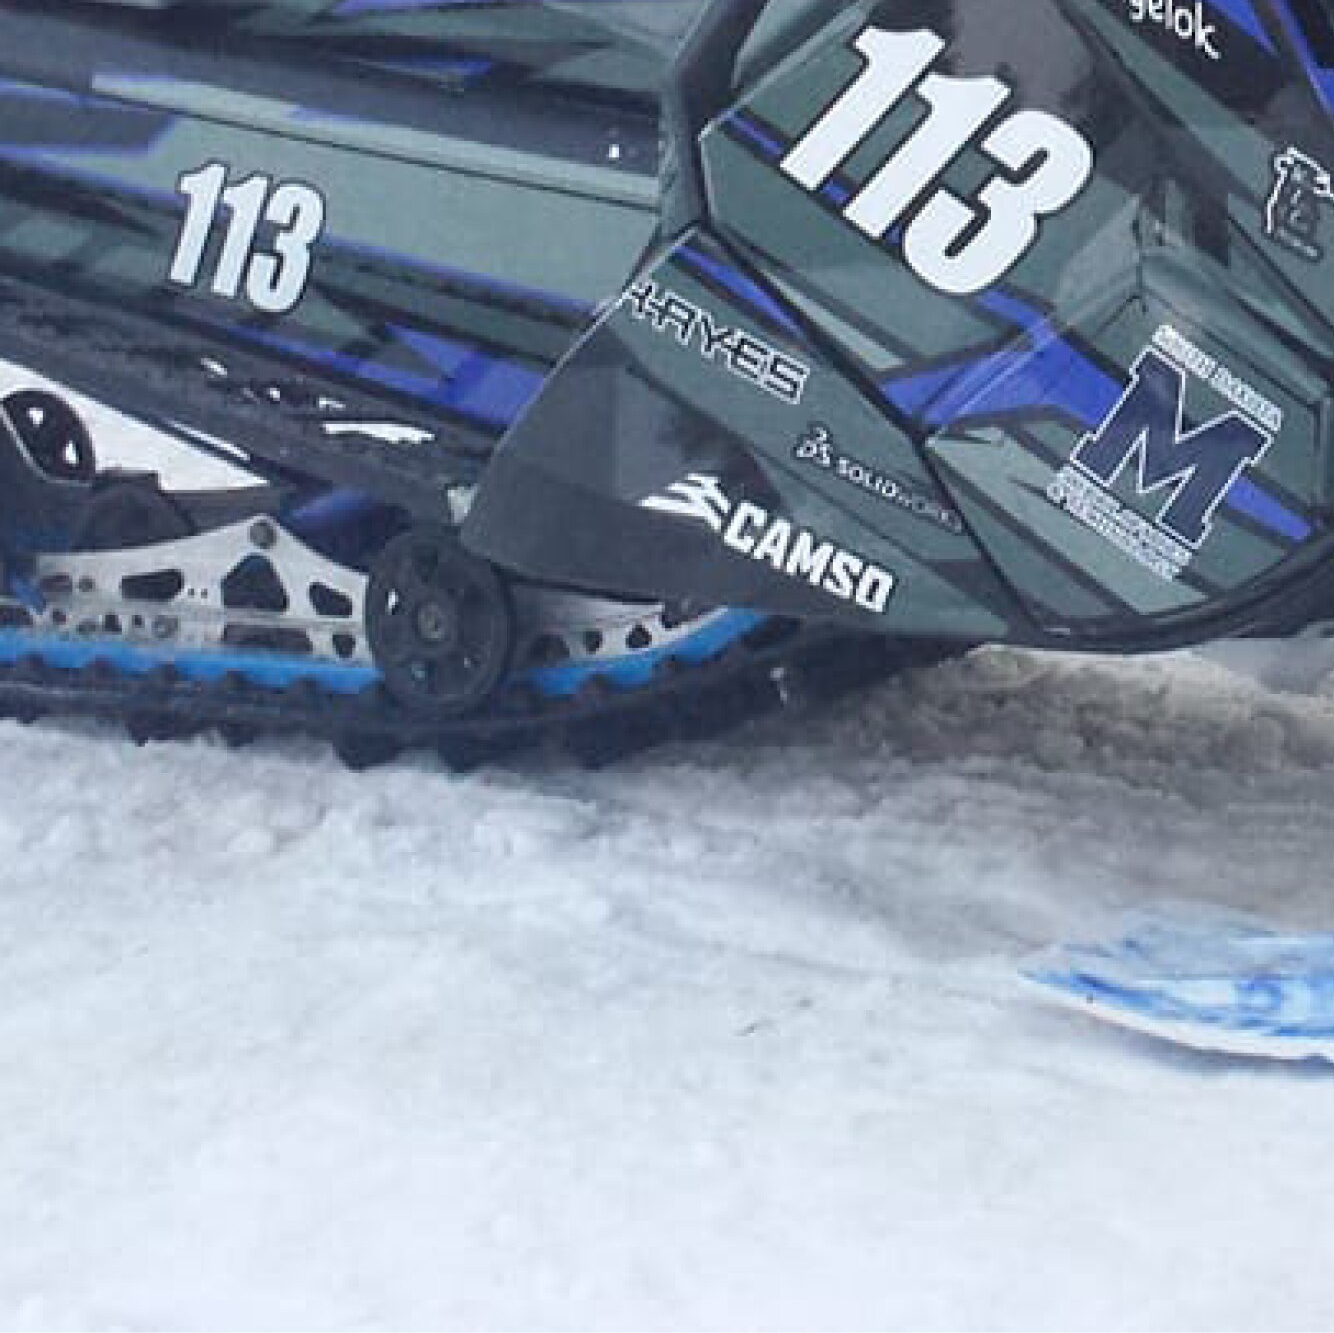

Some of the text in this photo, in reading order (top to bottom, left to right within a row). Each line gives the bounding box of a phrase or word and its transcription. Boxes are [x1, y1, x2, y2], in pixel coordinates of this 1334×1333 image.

[170, 162, 325, 313] 113
[780, 27, 1094, 293] 113
[1069, 345, 1274, 551] M
[724, 502, 893, 613] CAMSO
